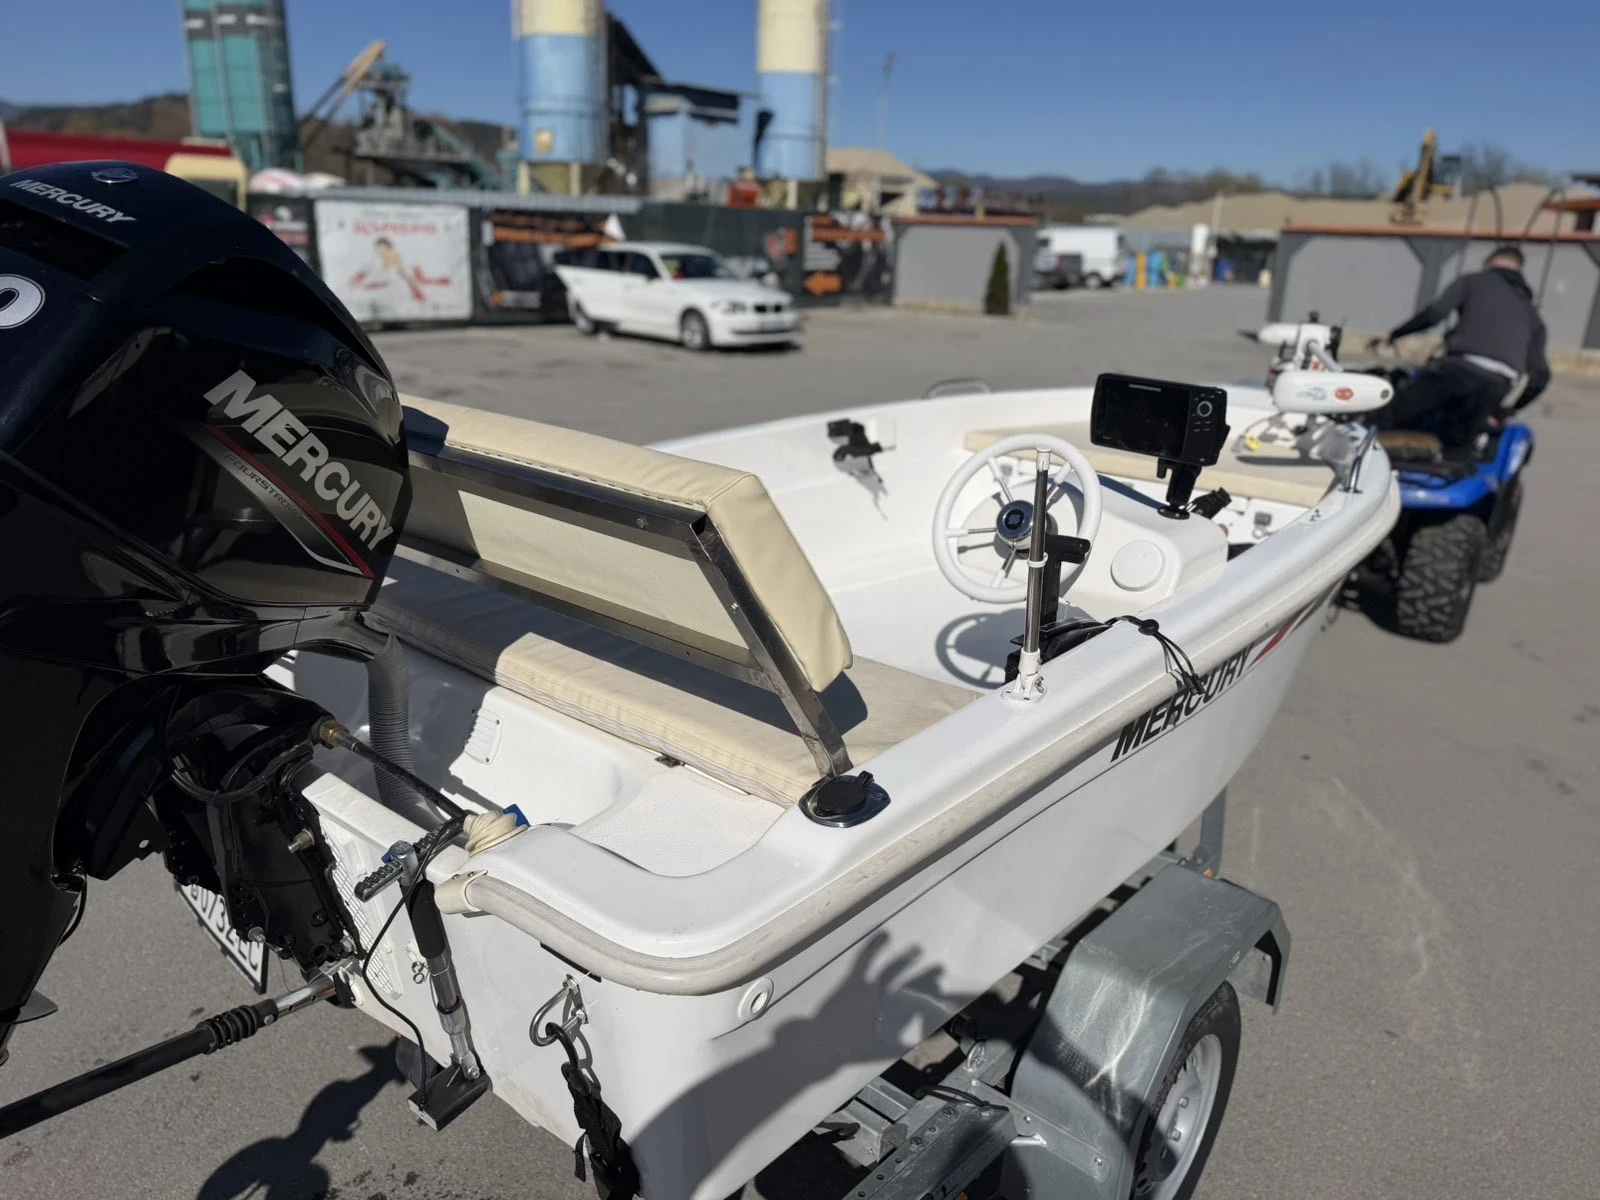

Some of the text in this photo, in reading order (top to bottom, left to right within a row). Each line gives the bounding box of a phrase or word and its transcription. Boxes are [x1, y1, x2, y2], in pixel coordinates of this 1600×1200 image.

[9, 179, 137, 222] MERCURY
[203, 369, 394, 551] MERCURY
[1110, 643, 1255, 763] MERCURY
